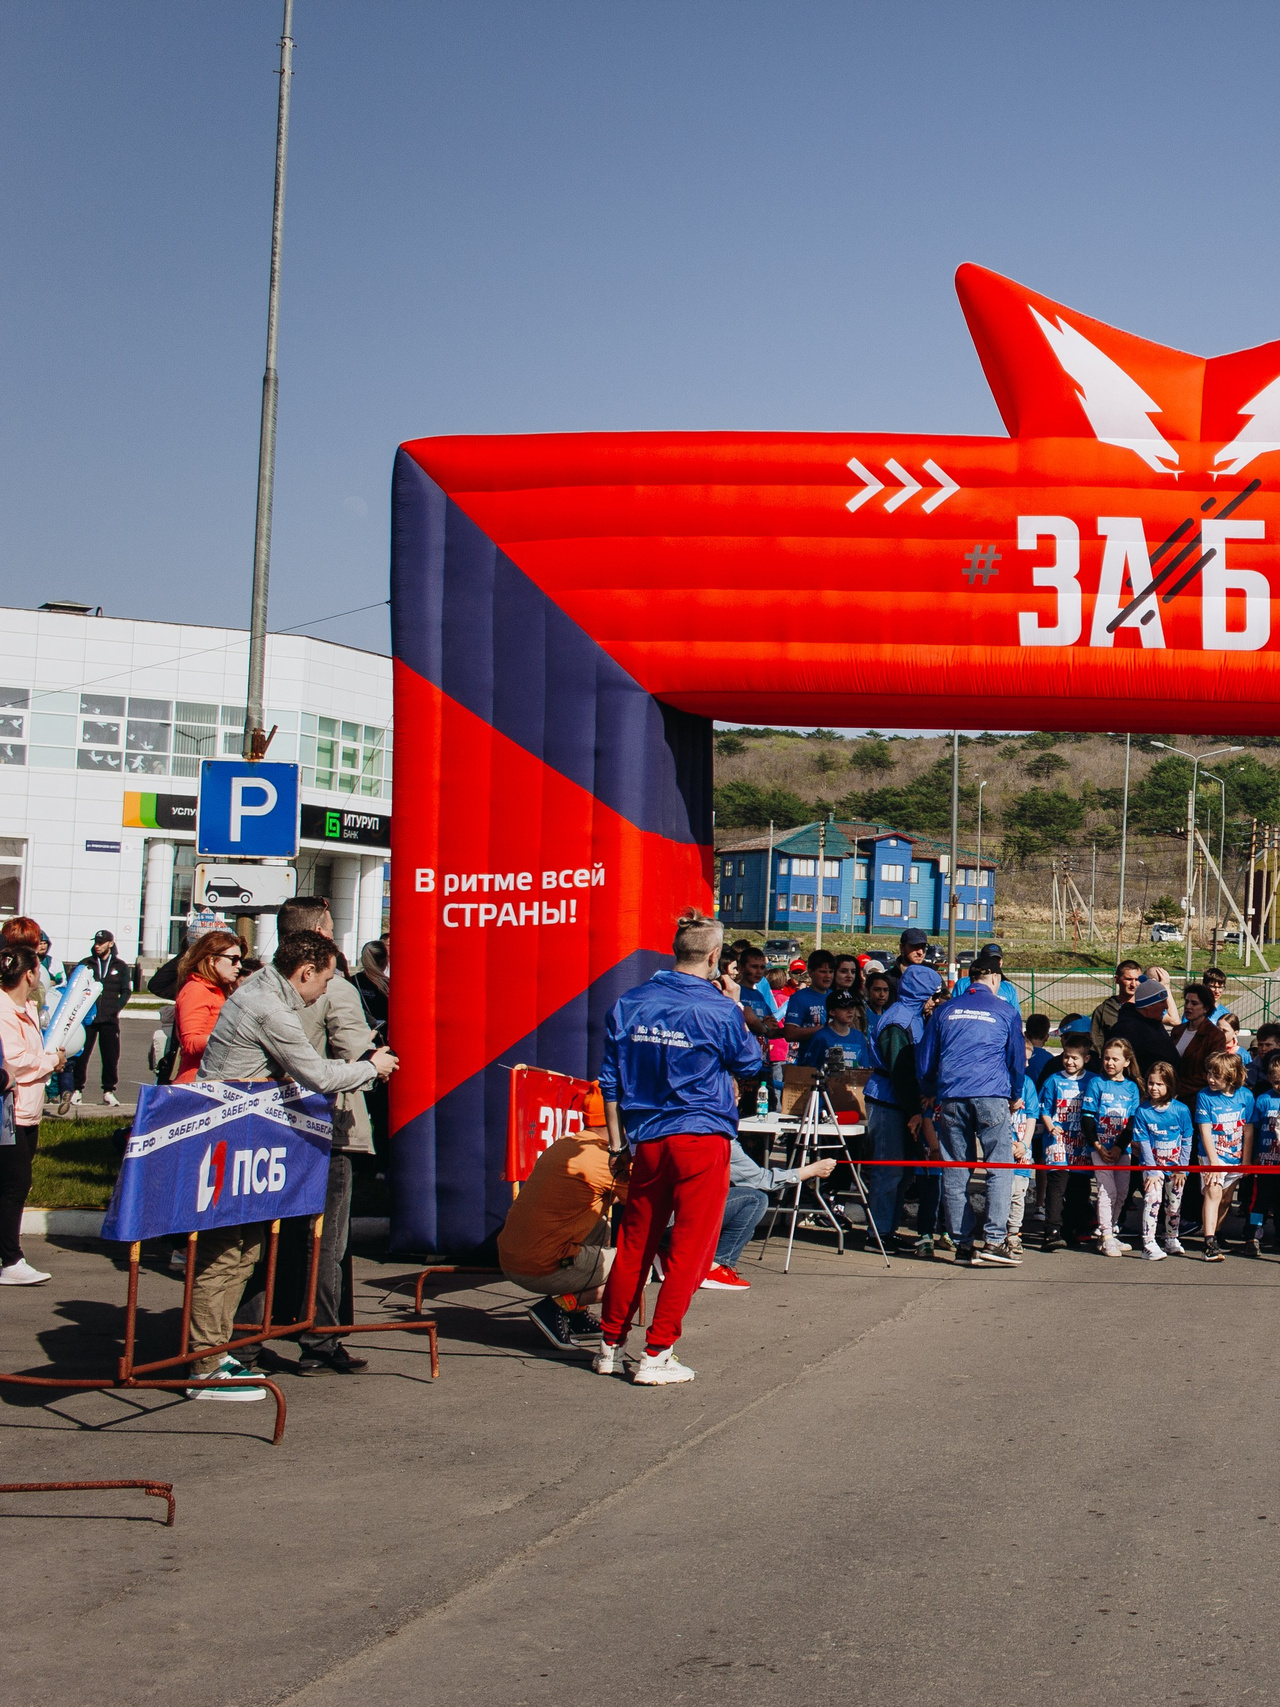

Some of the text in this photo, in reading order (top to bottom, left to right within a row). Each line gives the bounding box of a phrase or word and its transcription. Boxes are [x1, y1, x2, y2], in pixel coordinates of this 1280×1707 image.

[171, 806, 197, 817] УСЛУ
[343, 813, 380, 830] ИТУРУП
[343, 829, 359, 839] БАНК
[415, 862, 606, 896] В ритме всей
[442, 899, 577, 928] СТРАНЫ!
[221, 1098, 260, 1120] ЗАБЕГ.РФ
[264, 1106, 298, 1124] ЗАБЕГ.РФ
[167, 1116, 212, 1140] ЗАБЕГ.РФ
[305, 1120, 333, 1136] ЗАБЕГ.Р
[232, 1147, 287, 1197] ПСБ
